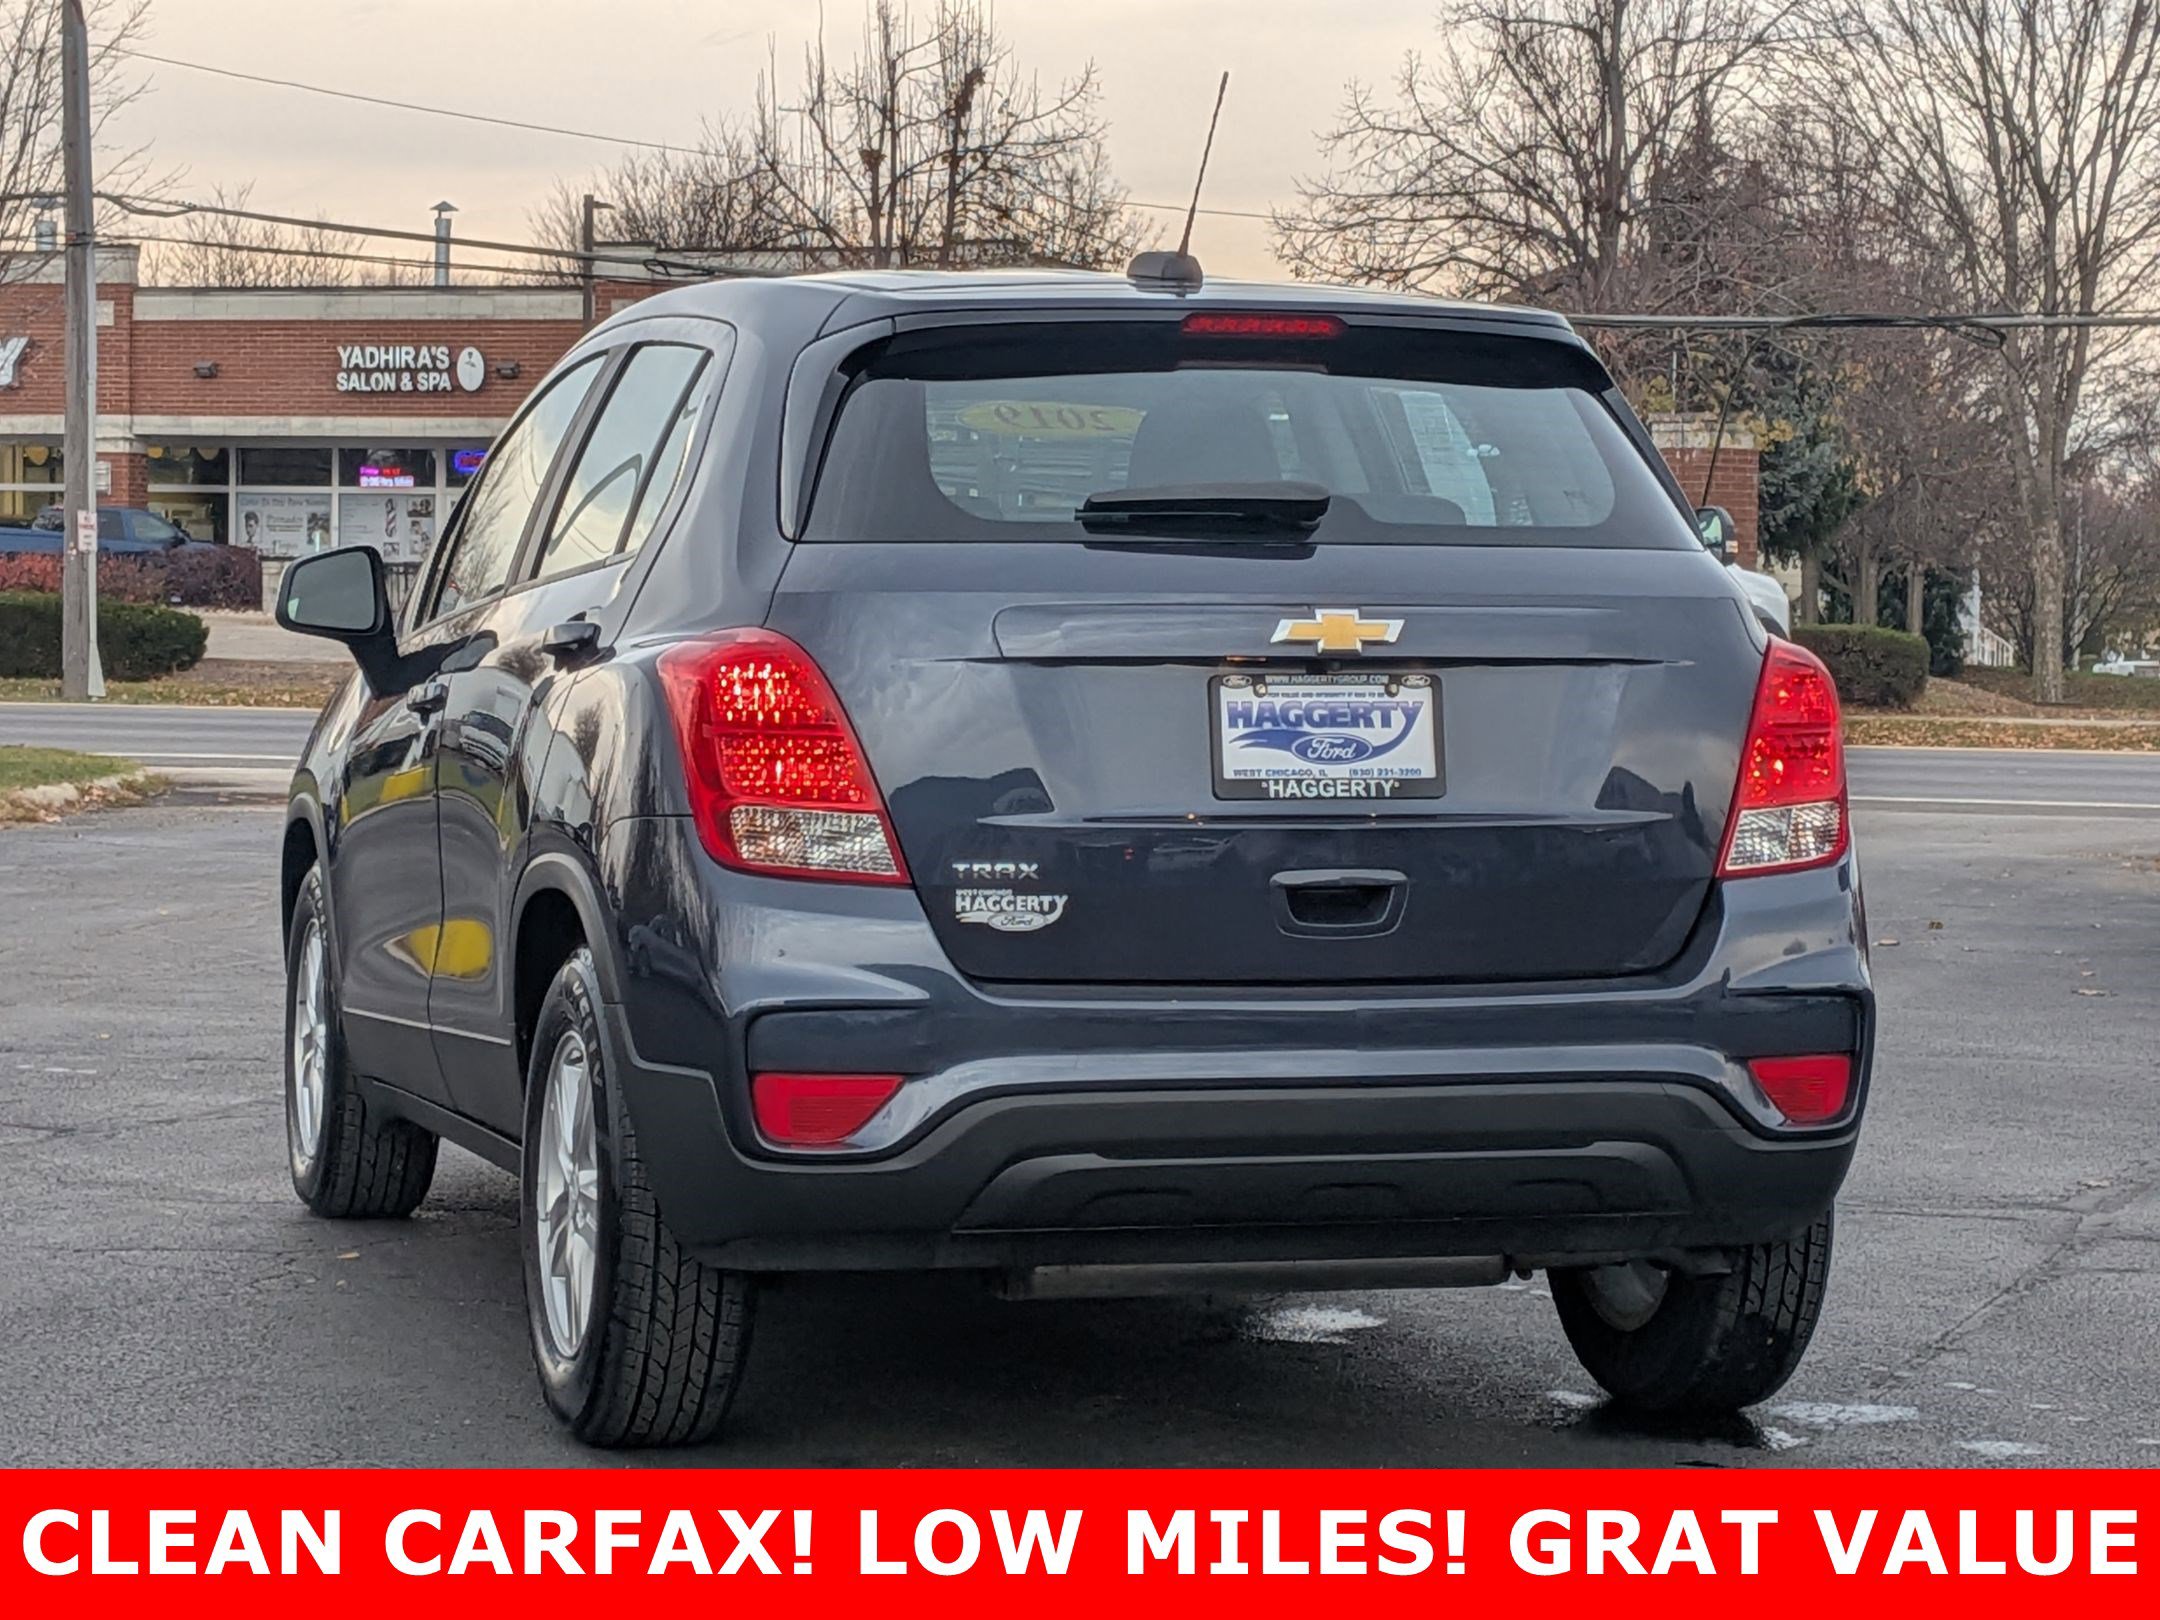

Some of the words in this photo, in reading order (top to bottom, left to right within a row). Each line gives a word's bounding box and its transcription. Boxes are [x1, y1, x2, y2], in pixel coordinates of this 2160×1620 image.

[336, 345, 450, 370] YADHIRA'S
[336, 371, 396, 391] SALON
[400, 371, 414, 391] &
[416, 371, 452, 391] SPA
[1226, 700, 1424, 728] HAGGERTY
[1307, 736, 1357, 760] Ford
[1233, 768, 1262, 778] WEST
[1268, 779, 1394, 799] HAGGERTY
[952, 862, 1040, 881] TRAX
[955, 894, 1069, 912] HAGGERTY
